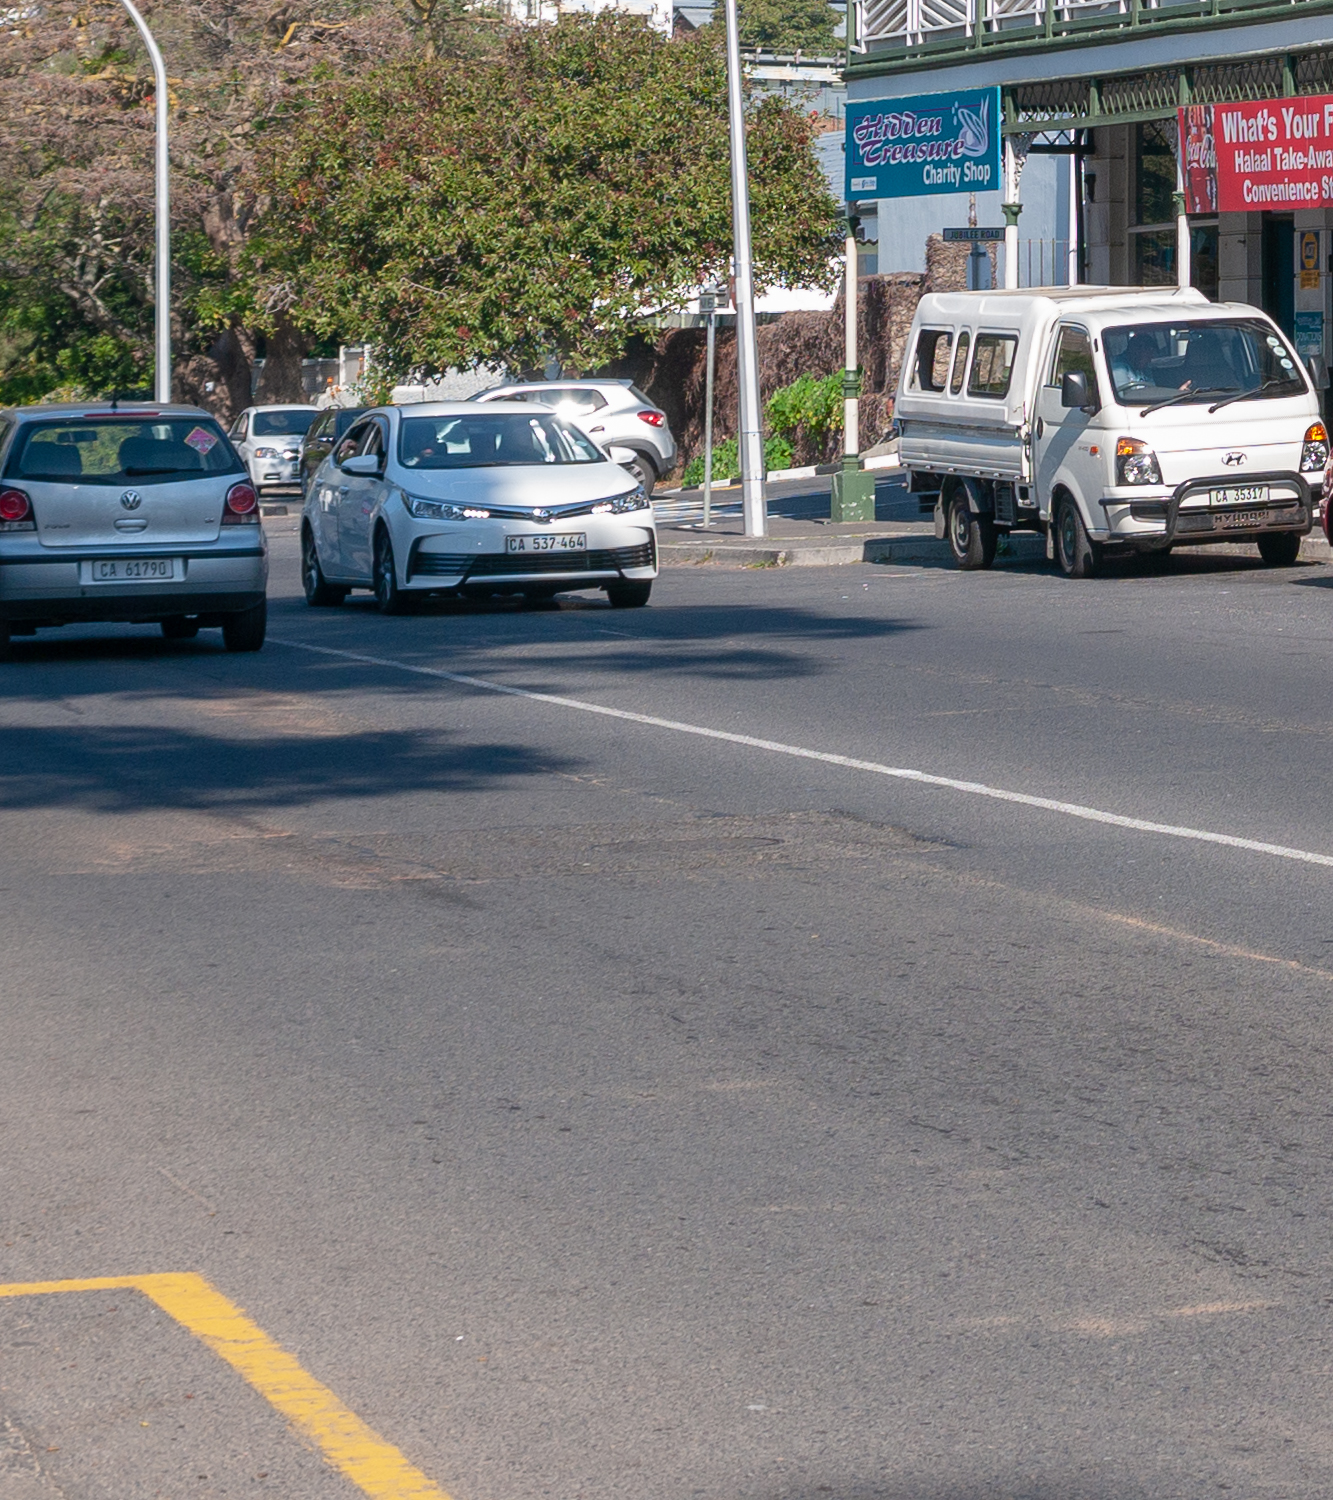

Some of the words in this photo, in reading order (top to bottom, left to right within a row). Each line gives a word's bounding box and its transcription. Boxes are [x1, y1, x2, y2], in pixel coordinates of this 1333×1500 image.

[853, 110, 943, 144] Hidden
[1221, 107, 1278, 144] What's
[1281, 106, 1320, 140] Your
[859, 138, 966, 167] Treasure
[1234, 148, 1272, 173] Halaal
[923, 162, 962, 188] Charity
[963, 160, 991, 185] Shop
[1243, 177, 1319, 203] Convenience
[949, 230, 979, 240] JUBILEE
[980, 230, 1000, 239] ROAD
[1215, 490, 1228, 503] CA
[1234, 486, 1263, 502] 35317
[509, 538, 525, 551] CA
[532, 536, 584, 550] 537-464
[100, 562, 117, 577] CA
[125, 561, 167, 577] 61790
